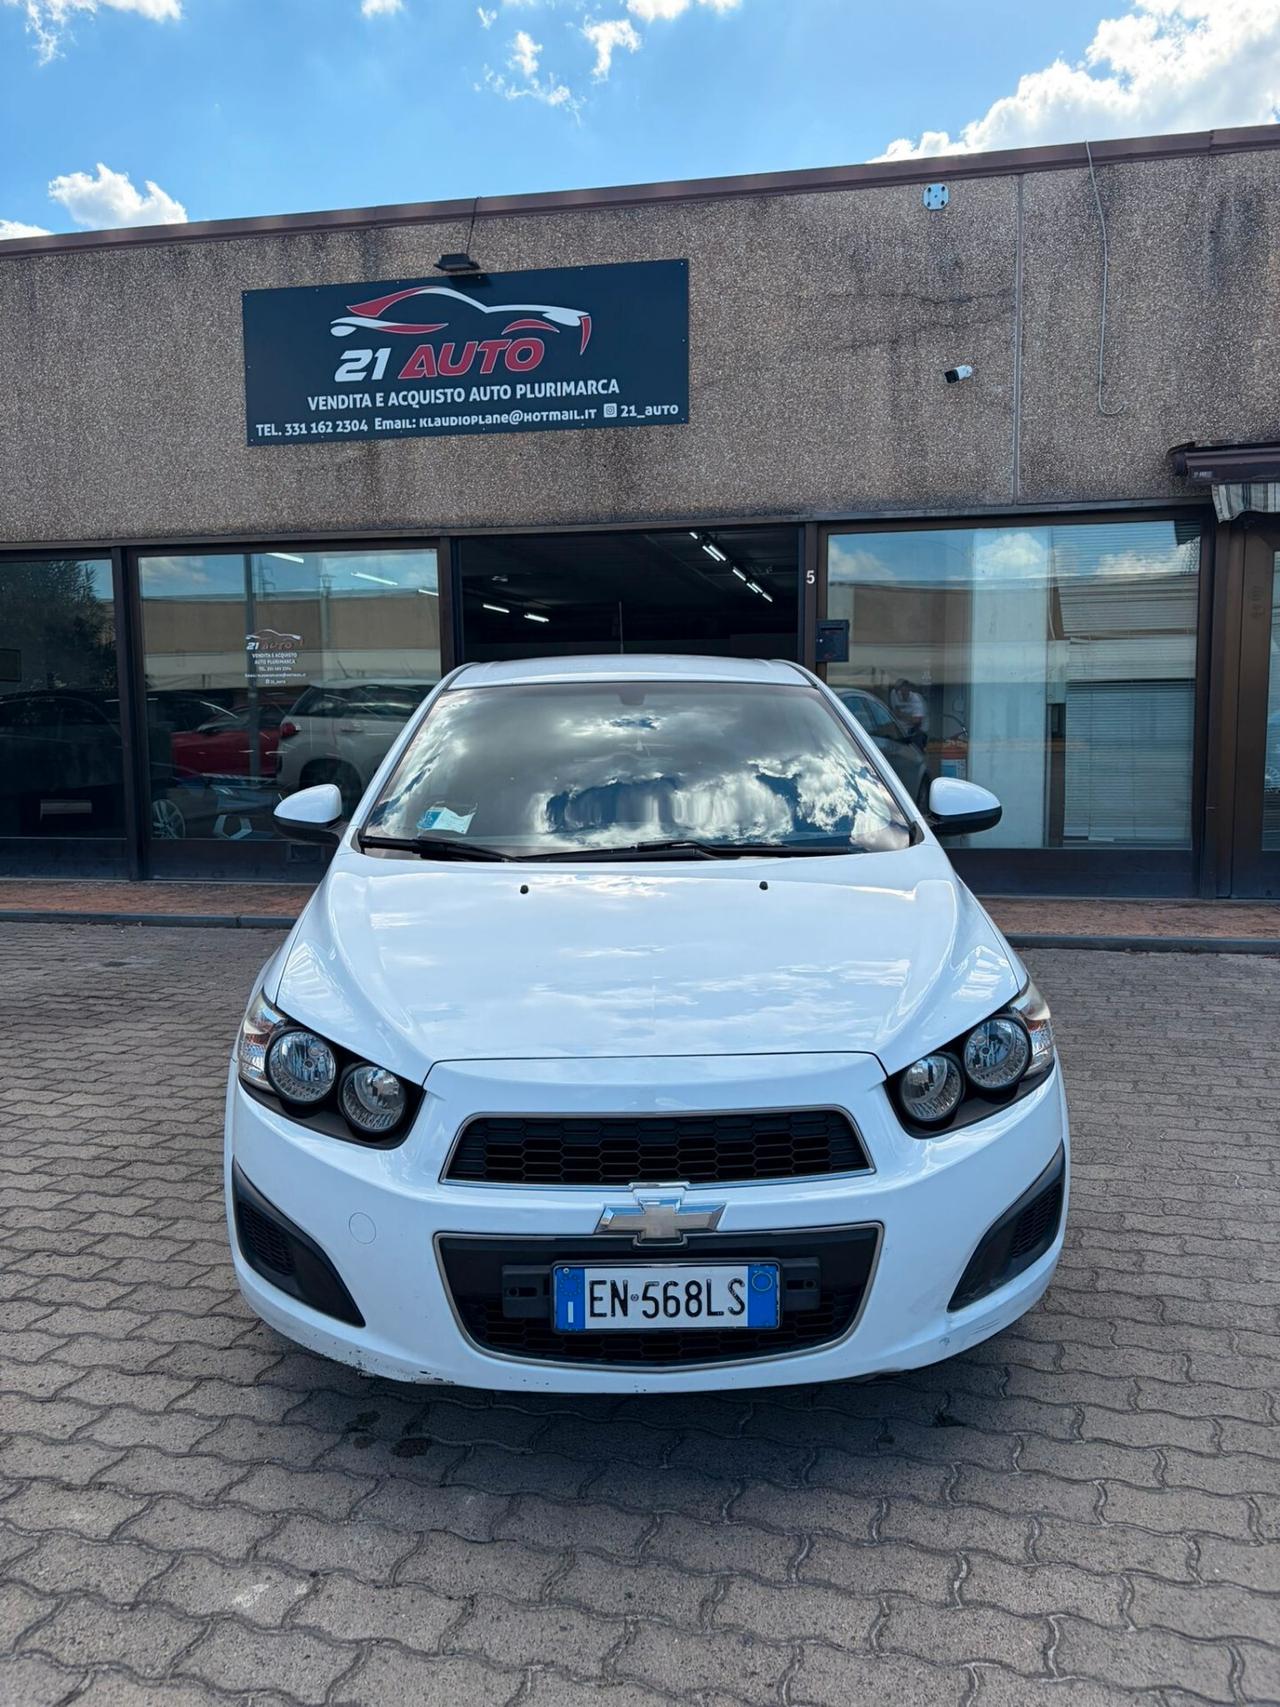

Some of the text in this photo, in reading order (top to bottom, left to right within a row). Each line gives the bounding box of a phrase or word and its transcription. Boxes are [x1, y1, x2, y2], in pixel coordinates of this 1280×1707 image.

[334, 337, 545, 382] 21 AUTO
[307, 378, 620, 410] VENDITA E ACQUISTO AUTO PLURIMARCA
[256, 423, 282, 436] TEL.
[284, 422, 308, 436] 331
[310, 420, 333, 434] 162
[335, 419, 368, 433] 2304
[806, 570, 815, 584] 5
[246, 641, 259, 650] 21
